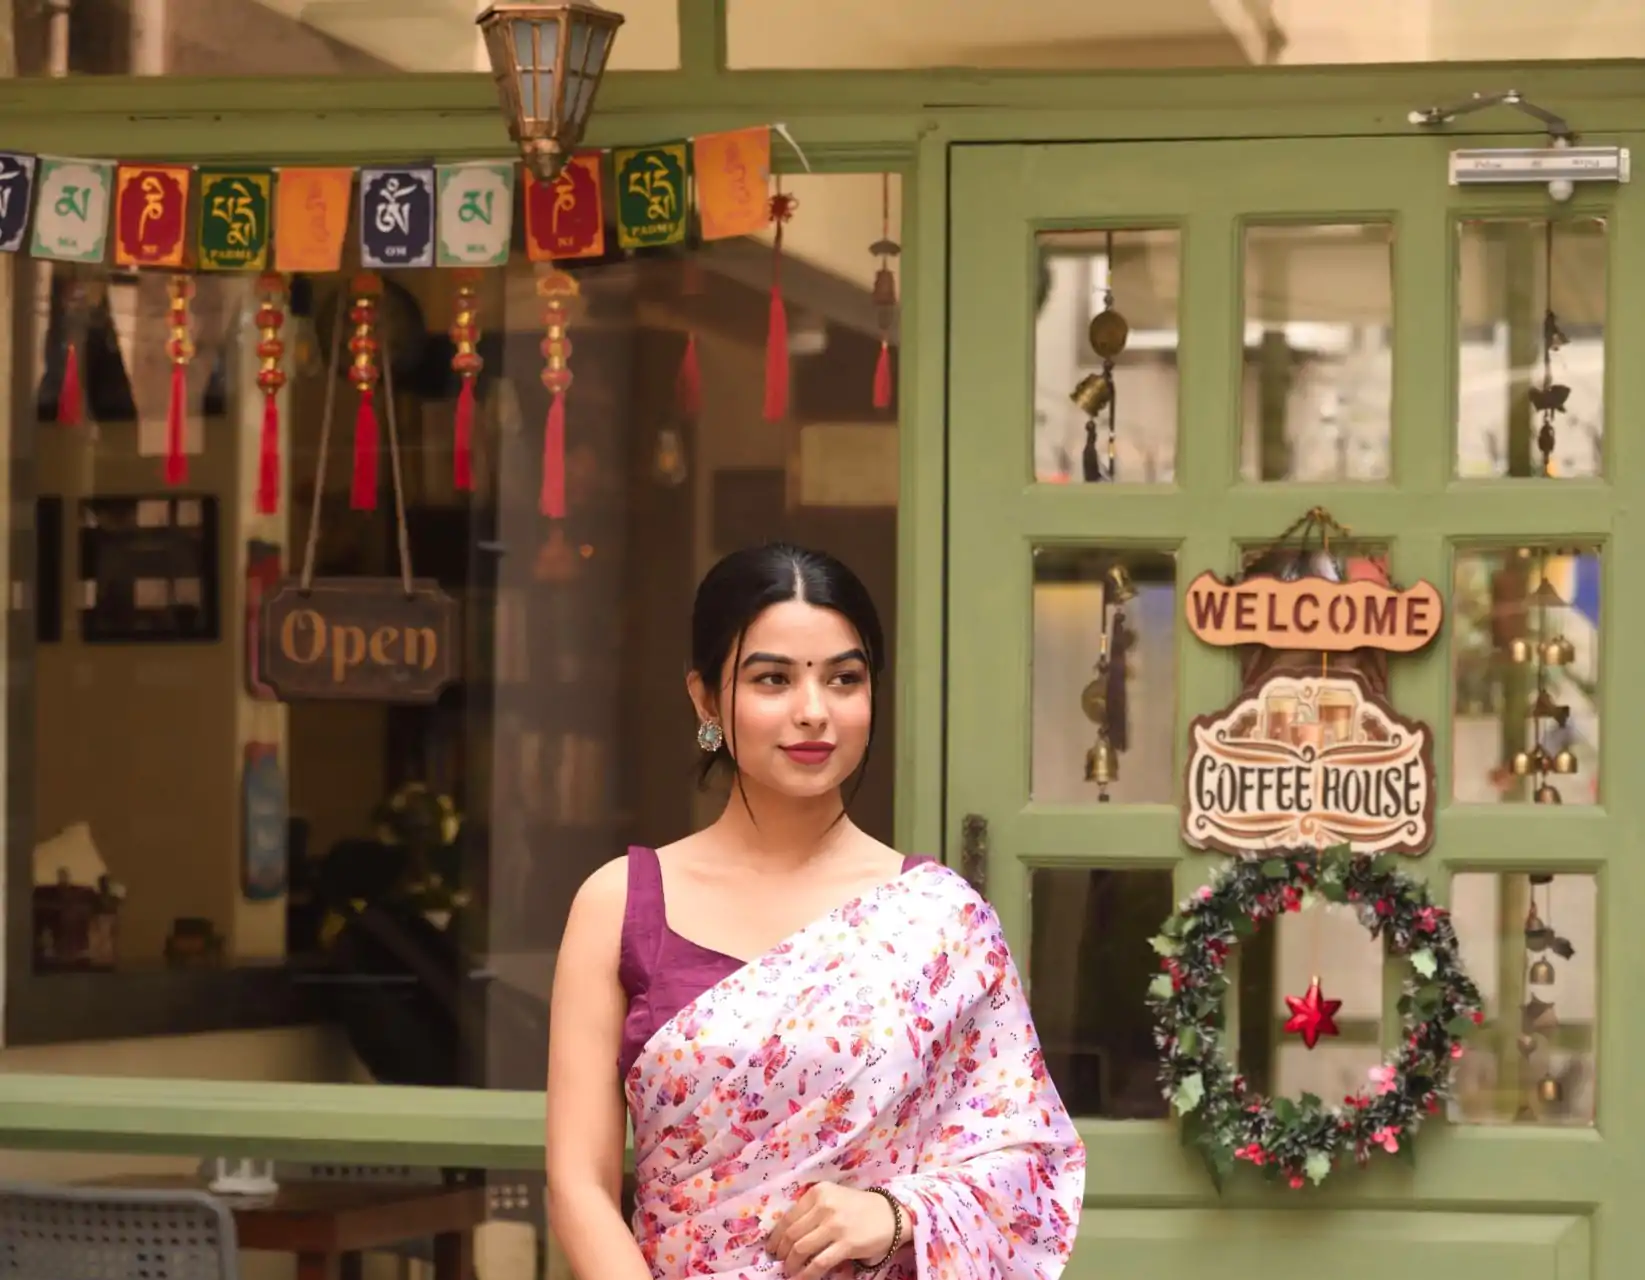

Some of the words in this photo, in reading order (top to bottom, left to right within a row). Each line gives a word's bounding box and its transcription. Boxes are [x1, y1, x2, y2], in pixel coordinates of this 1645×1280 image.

[281, 608, 437, 683] Open
[1192, 590, 1431, 637] WELCOME
[1195, 754, 1313, 814] COFFEE
[1321, 758, 1422, 818] HOUSE
